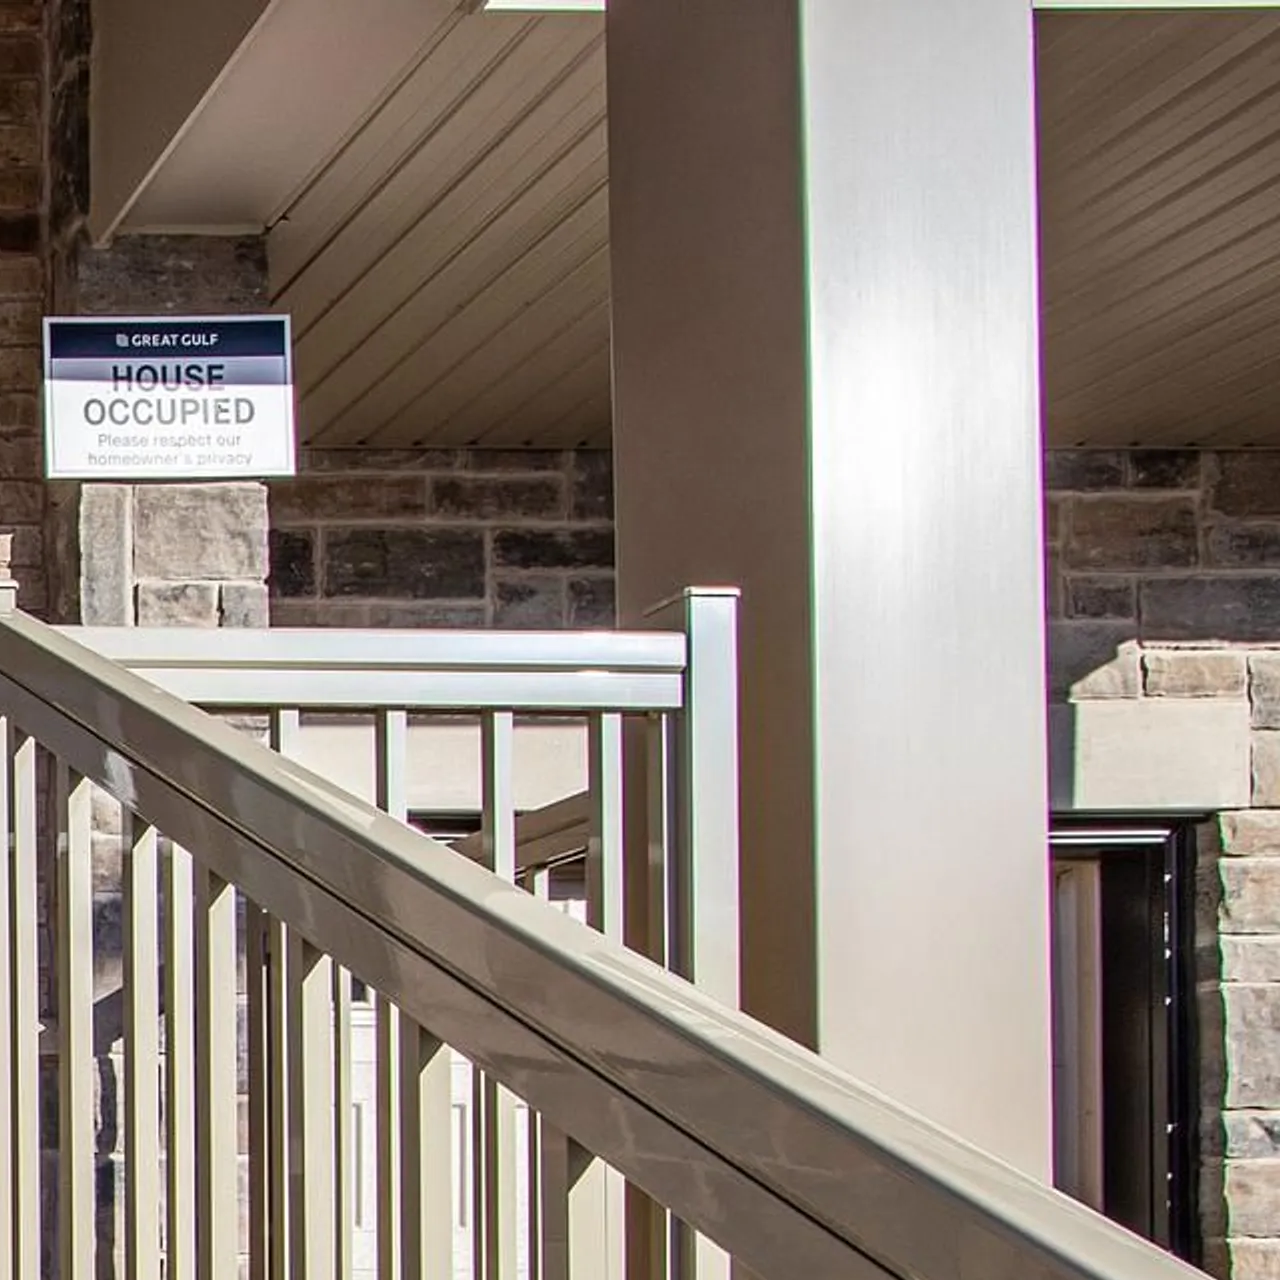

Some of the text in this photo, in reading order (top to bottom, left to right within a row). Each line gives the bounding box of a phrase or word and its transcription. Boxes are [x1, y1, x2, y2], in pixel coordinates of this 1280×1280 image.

[131, 333, 220, 347] GREAT GULF
[112, 364, 225, 392] HOUSE
[83, 398, 255, 425] OCCUPIED
[98, 433, 241, 449] Please respect our
[197, 453, 253, 467] privacy
